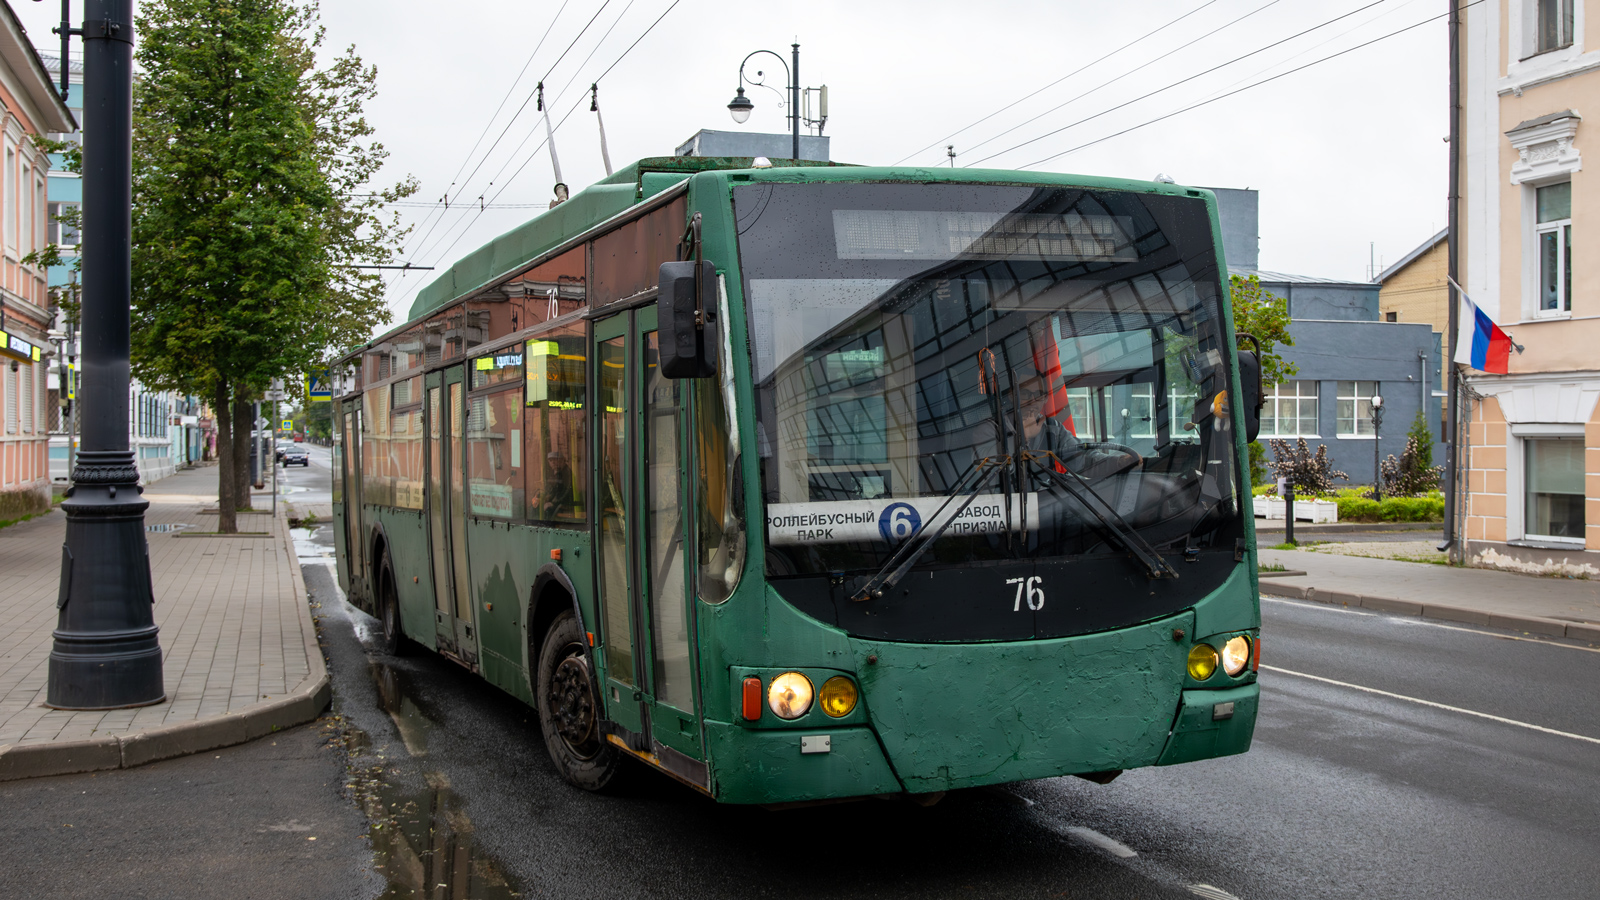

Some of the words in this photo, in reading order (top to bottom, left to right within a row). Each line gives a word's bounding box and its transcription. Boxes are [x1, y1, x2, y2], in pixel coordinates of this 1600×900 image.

[546, 287, 558, 321] 76
[797, 528, 834, 541] ПАРК
[889, 506, 913, 539] 6
[1005, 575, 1045, 612] 76
